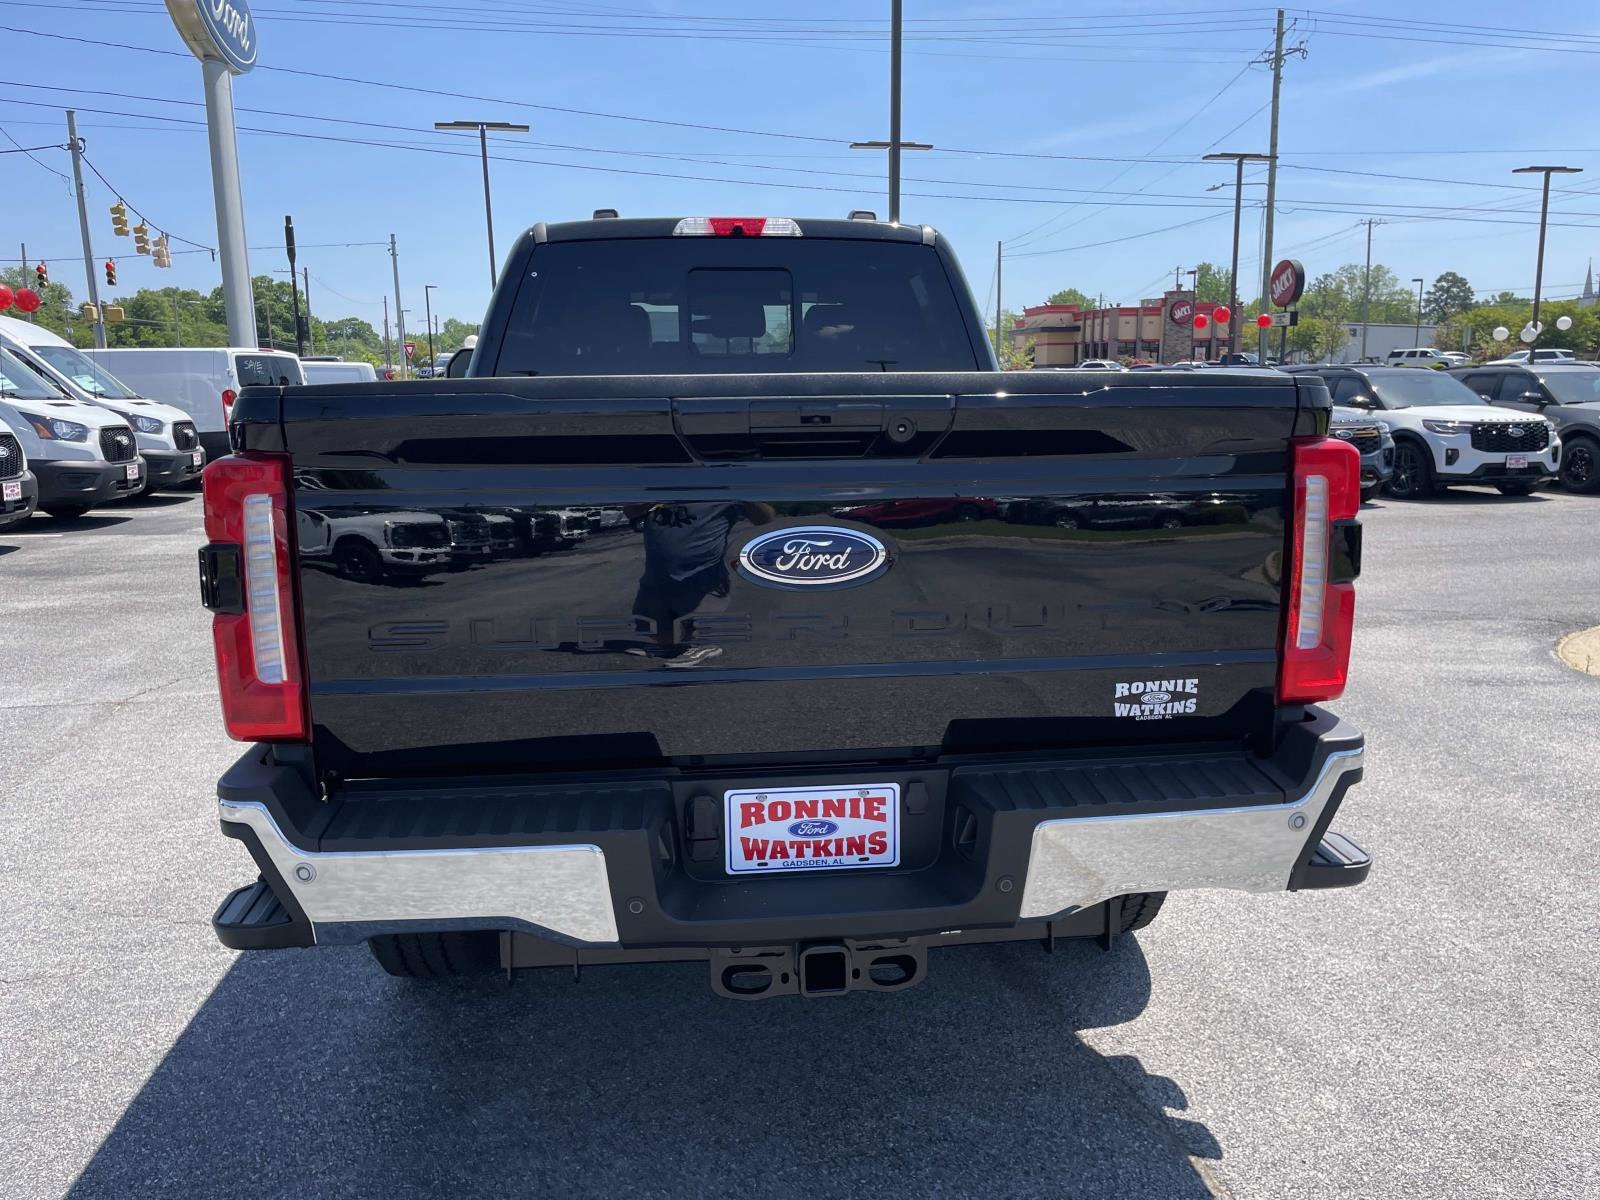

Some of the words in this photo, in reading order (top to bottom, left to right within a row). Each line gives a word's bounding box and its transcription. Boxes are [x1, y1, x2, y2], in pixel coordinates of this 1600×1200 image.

[775, 539, 852, 571] Ford
[1115, 679, 1198, 698] RONNIE
[1114, 698, 1197, 717] WATKINS
[740, 797, 886, 829] RONNIE
[798, 822, 829, 836] Ford
[740, 831, 887, 861] WATKINS
[832, 858, 844, 866] AL
